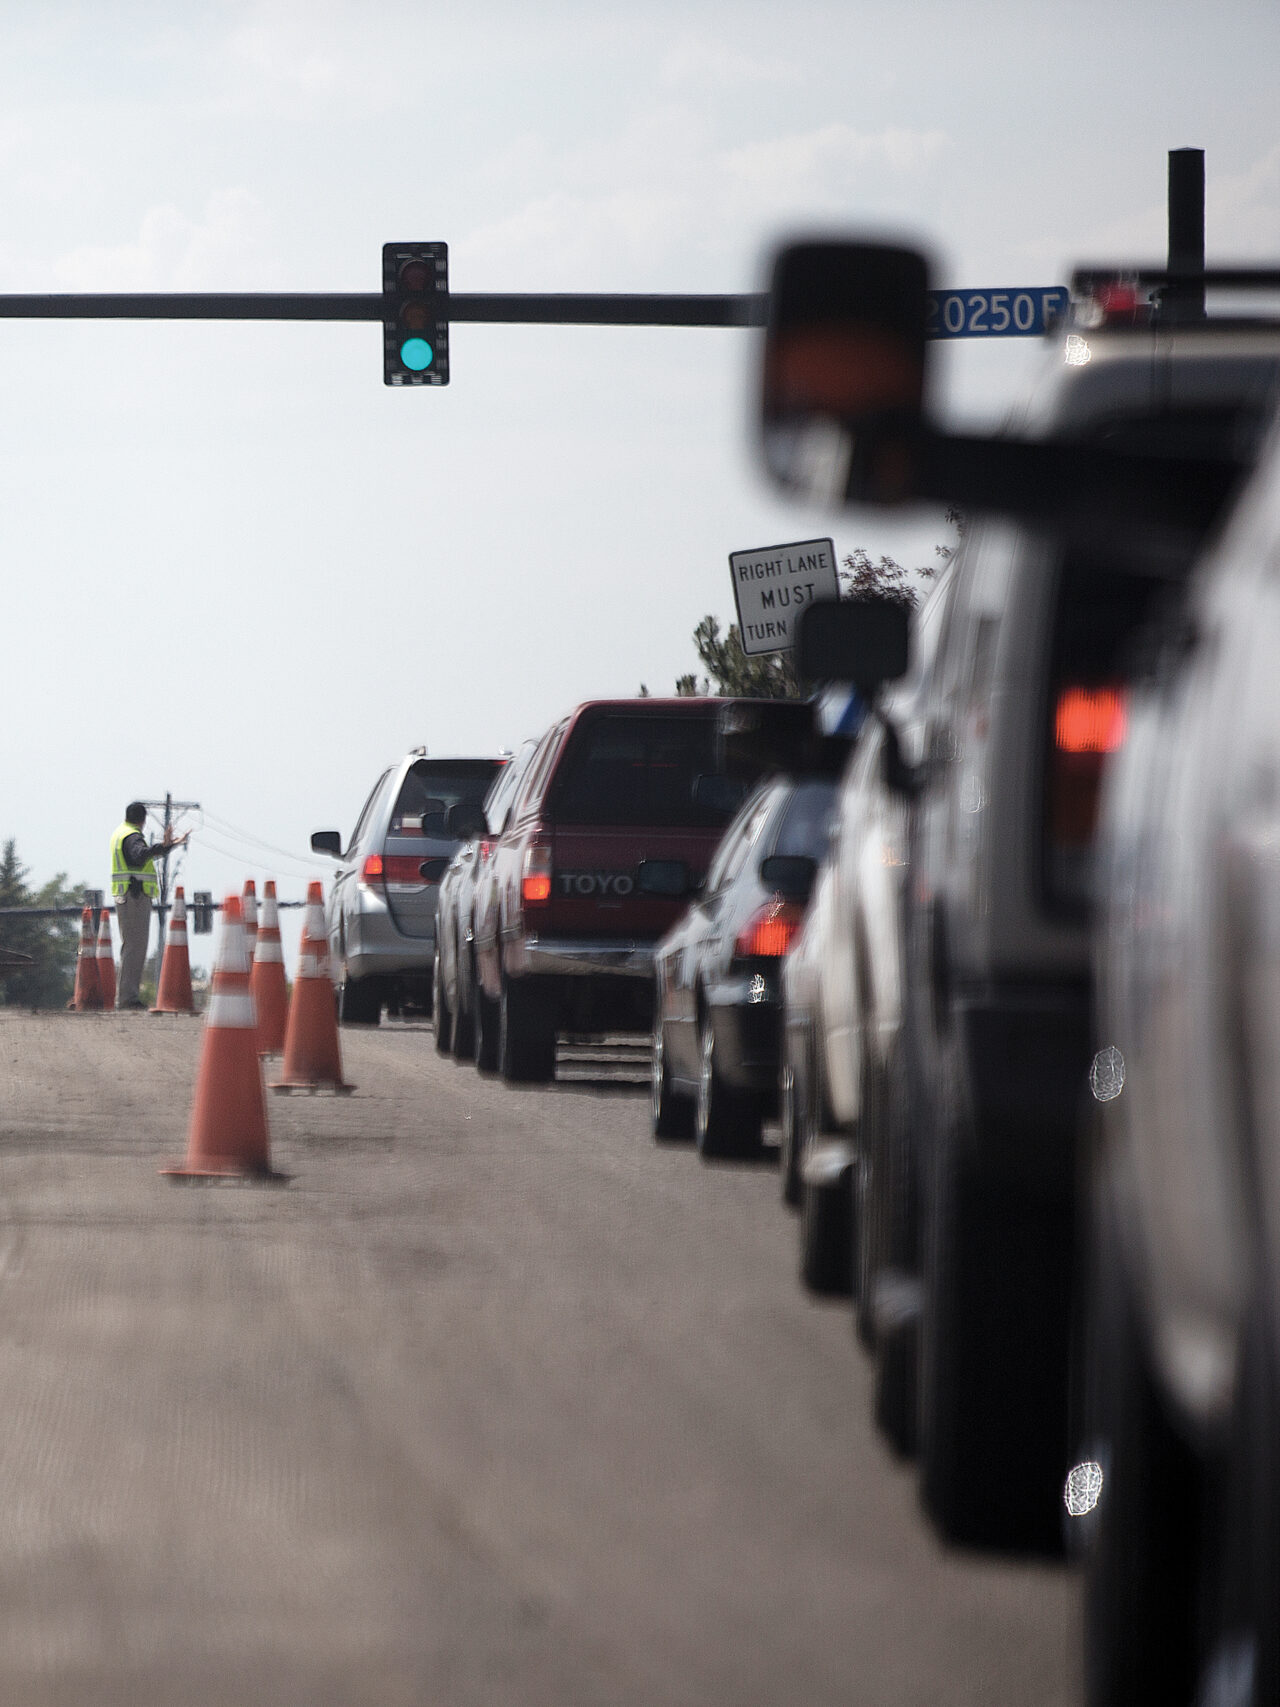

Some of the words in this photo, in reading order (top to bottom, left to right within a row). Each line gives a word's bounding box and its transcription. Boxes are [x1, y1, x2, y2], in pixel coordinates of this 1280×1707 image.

[739, 560, 783, 582] RIGHT
[787, 553, 829, 574] LANE
[761, 583, 815, 609] MUST
[746, 620, 787, 641] TURN
[559, 874, 635, 895] TOYO
